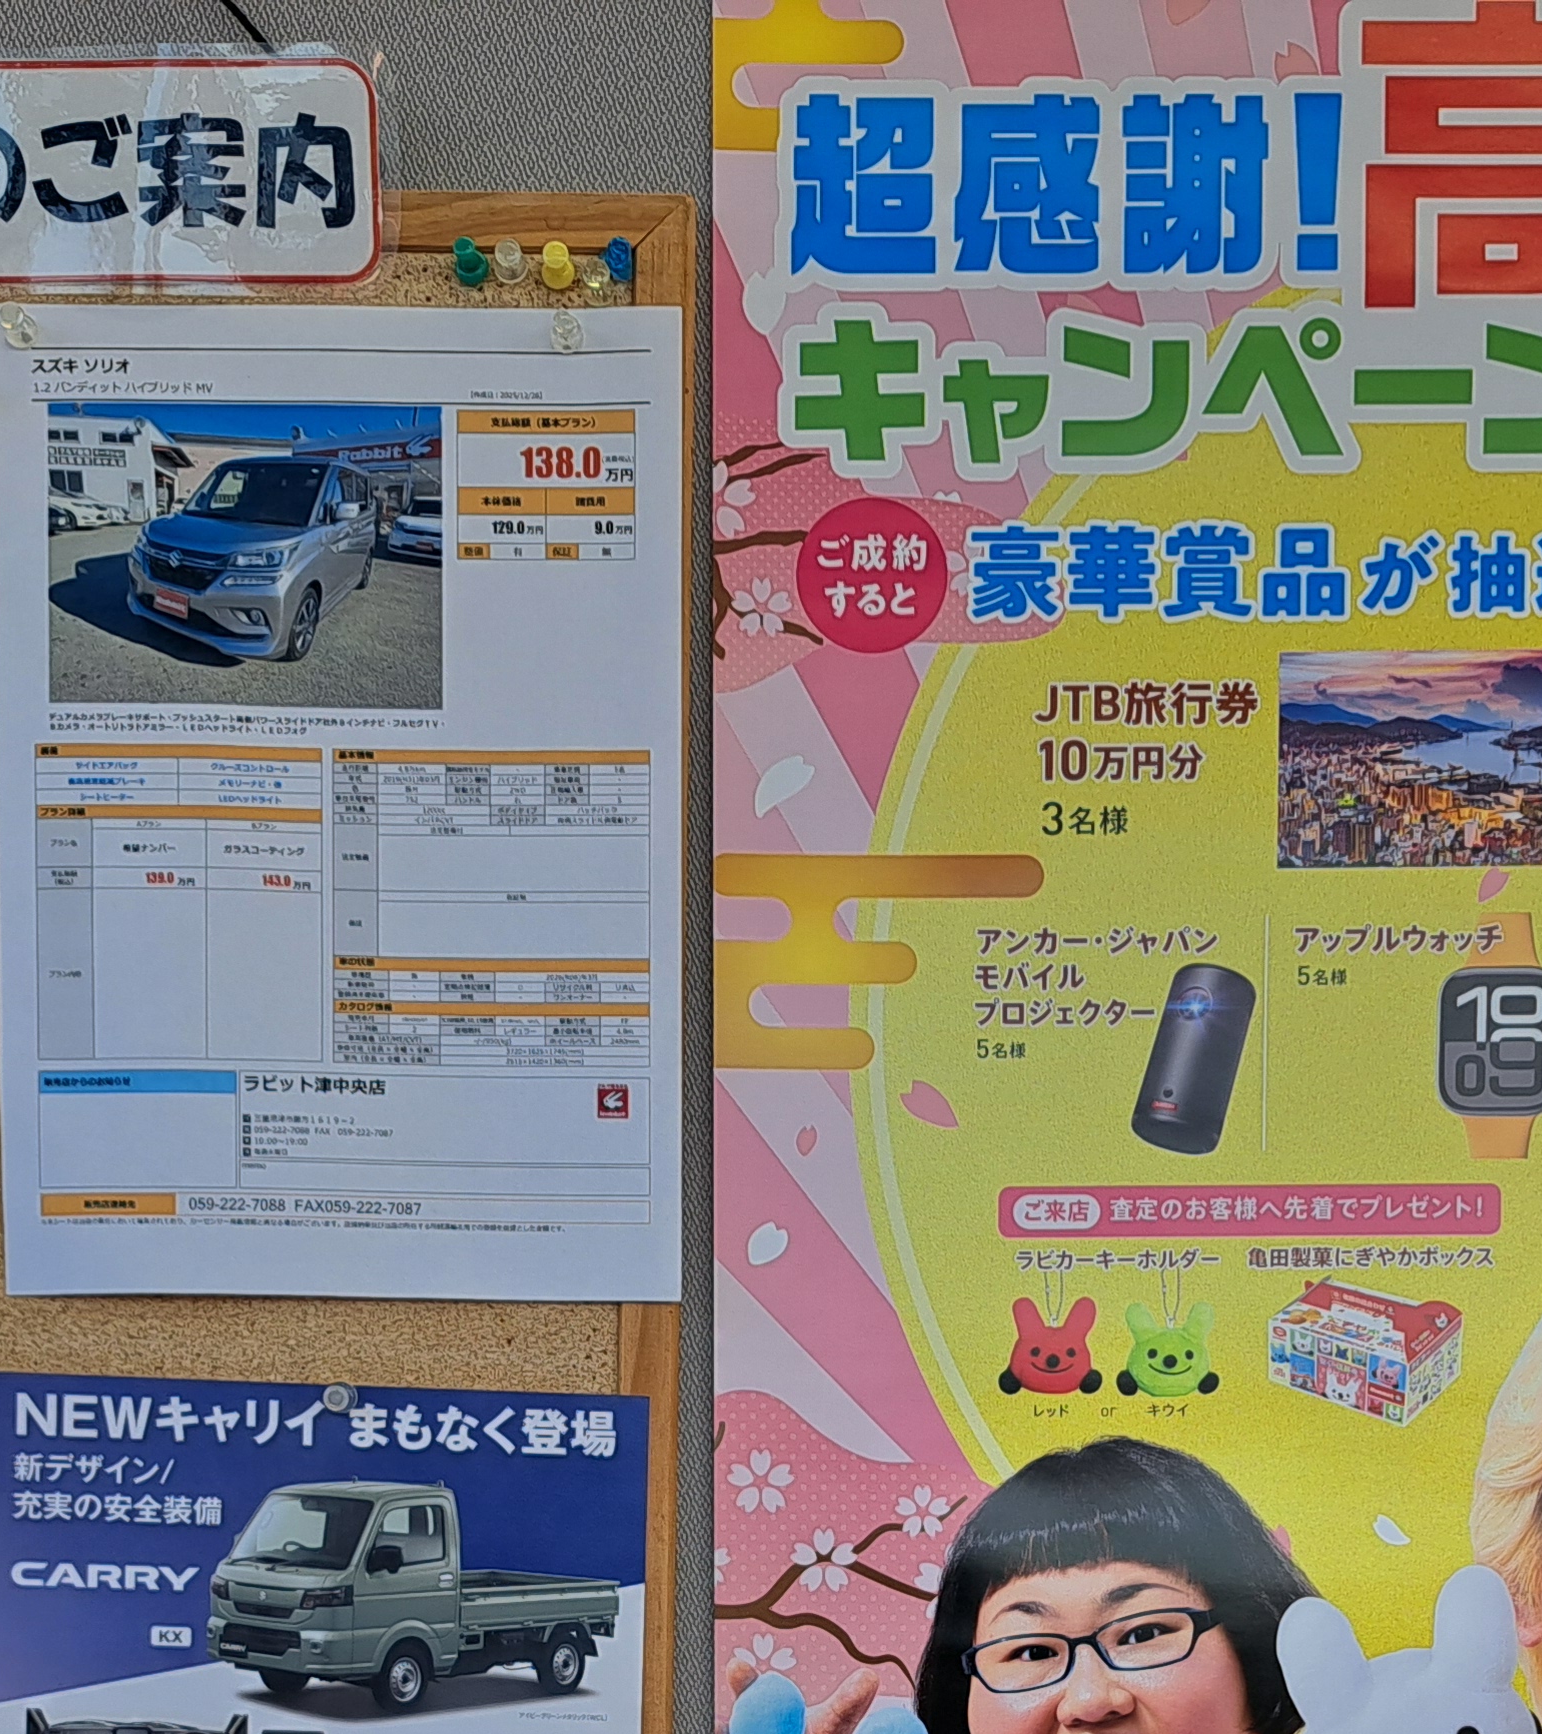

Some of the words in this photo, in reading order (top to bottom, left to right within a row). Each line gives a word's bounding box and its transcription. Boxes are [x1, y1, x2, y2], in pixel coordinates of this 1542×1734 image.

[791, 92, 1343, 275] 超感謝!
[32, 359, 79, 374] スズキ
[85, 359, 130, 373] ソリオ
[33, 383, 51, 393] 1.2
[196, 383, 213, 393] MV
[816, 533, 927, 570] ご成約
[824, 582, 916, 617] すると
[1035, 683, 1259, 726] JTB旅行券
[1037, 739, 1205, 781] 10万円分
[1041, 803, 1129, 836] 3名様
[976, 928, 1218, 956] アンカー・ジャパン
[1294, 925, 1502, 954] アップルウォッチ
[975, 965, 1084, 991] モバイル
[1297, 967, 1348, 987] 5名様
[975, 1000, 1156, 1026] プロジェクター
[976, 1039, 1027, 1060] 5名様
[243, 1076, 386, 1095] ラビット津中央店
[189, 1198, 285, 1213] 059-222-7088
[295, 1200, 421, 1216] FAX059-222-7087
[1023, 1199, 1089, 1225] ご来店
[1110, 1195, 1485, 1222] 査定のお客様へ先着でプレゼント!
[1016, 1249, 1221, 1270] ラビカーキーホルダー
[1248, 1247, 1495, 1269] 亀田製菓にぎやかボックス
[1033, 1404, 1070, 1417] レッド
[1101, 1405, 1118, 1417] or
[1147, 1402, 1189, 1417] キウイ
[348, 1405, 617, 1458] まもなく登場
[13, 1492, 223, 1527] 充実の安全装備
[10, 1561, 200, 1592] CARRY
[158, 1628, 185, 1645] KX
